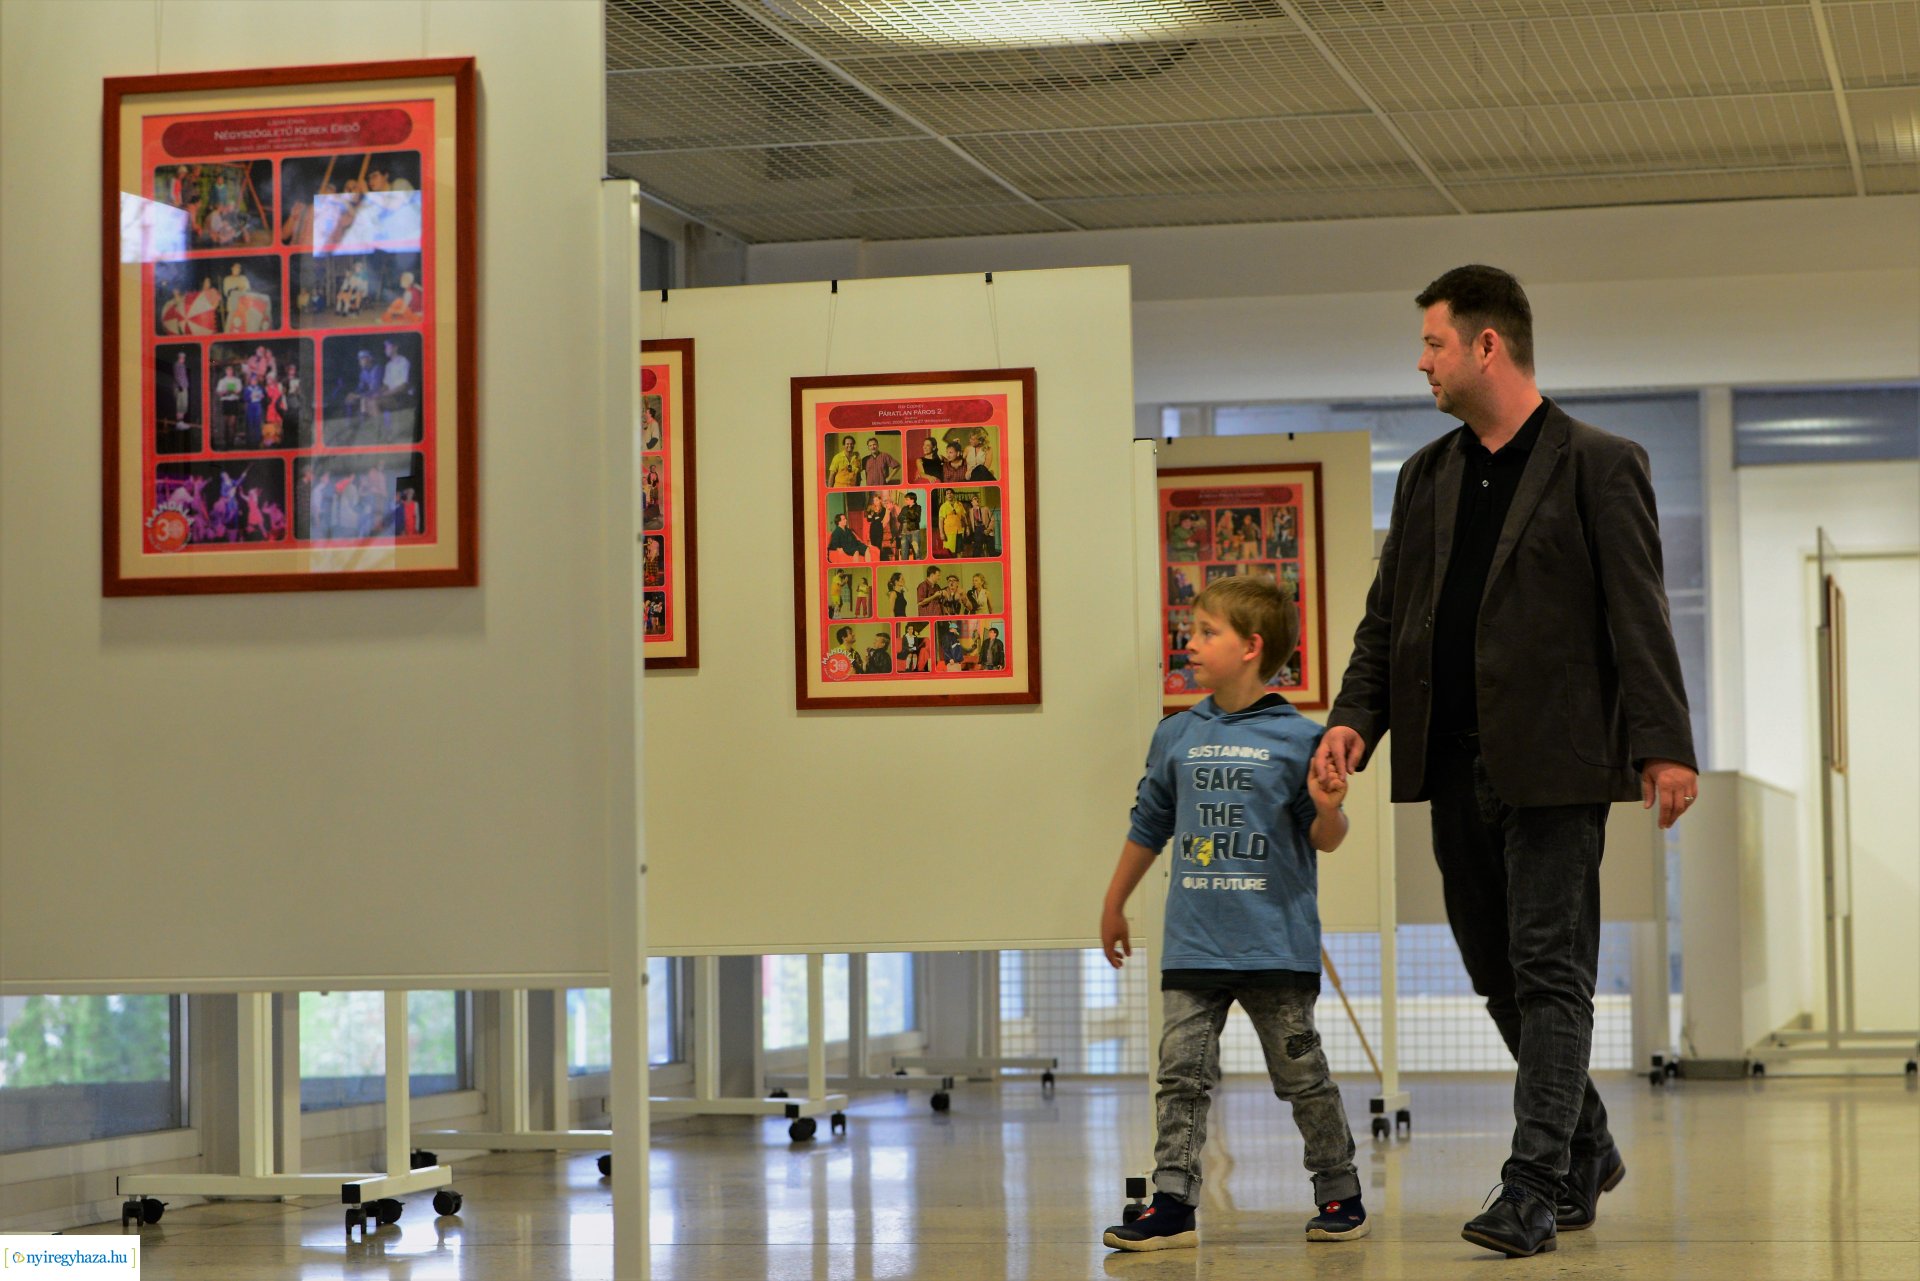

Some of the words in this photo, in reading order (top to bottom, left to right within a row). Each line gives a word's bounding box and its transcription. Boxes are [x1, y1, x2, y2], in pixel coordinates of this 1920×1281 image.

[1187, 744, 1270, 761] SUSTAINING
[1193, 767, 1254, 792] SAVE
[1196, 801, 1246, 829] THE
[1182, 876, 1208, 890] OUR
[1212, 877, 1268, 891] FUTURE
